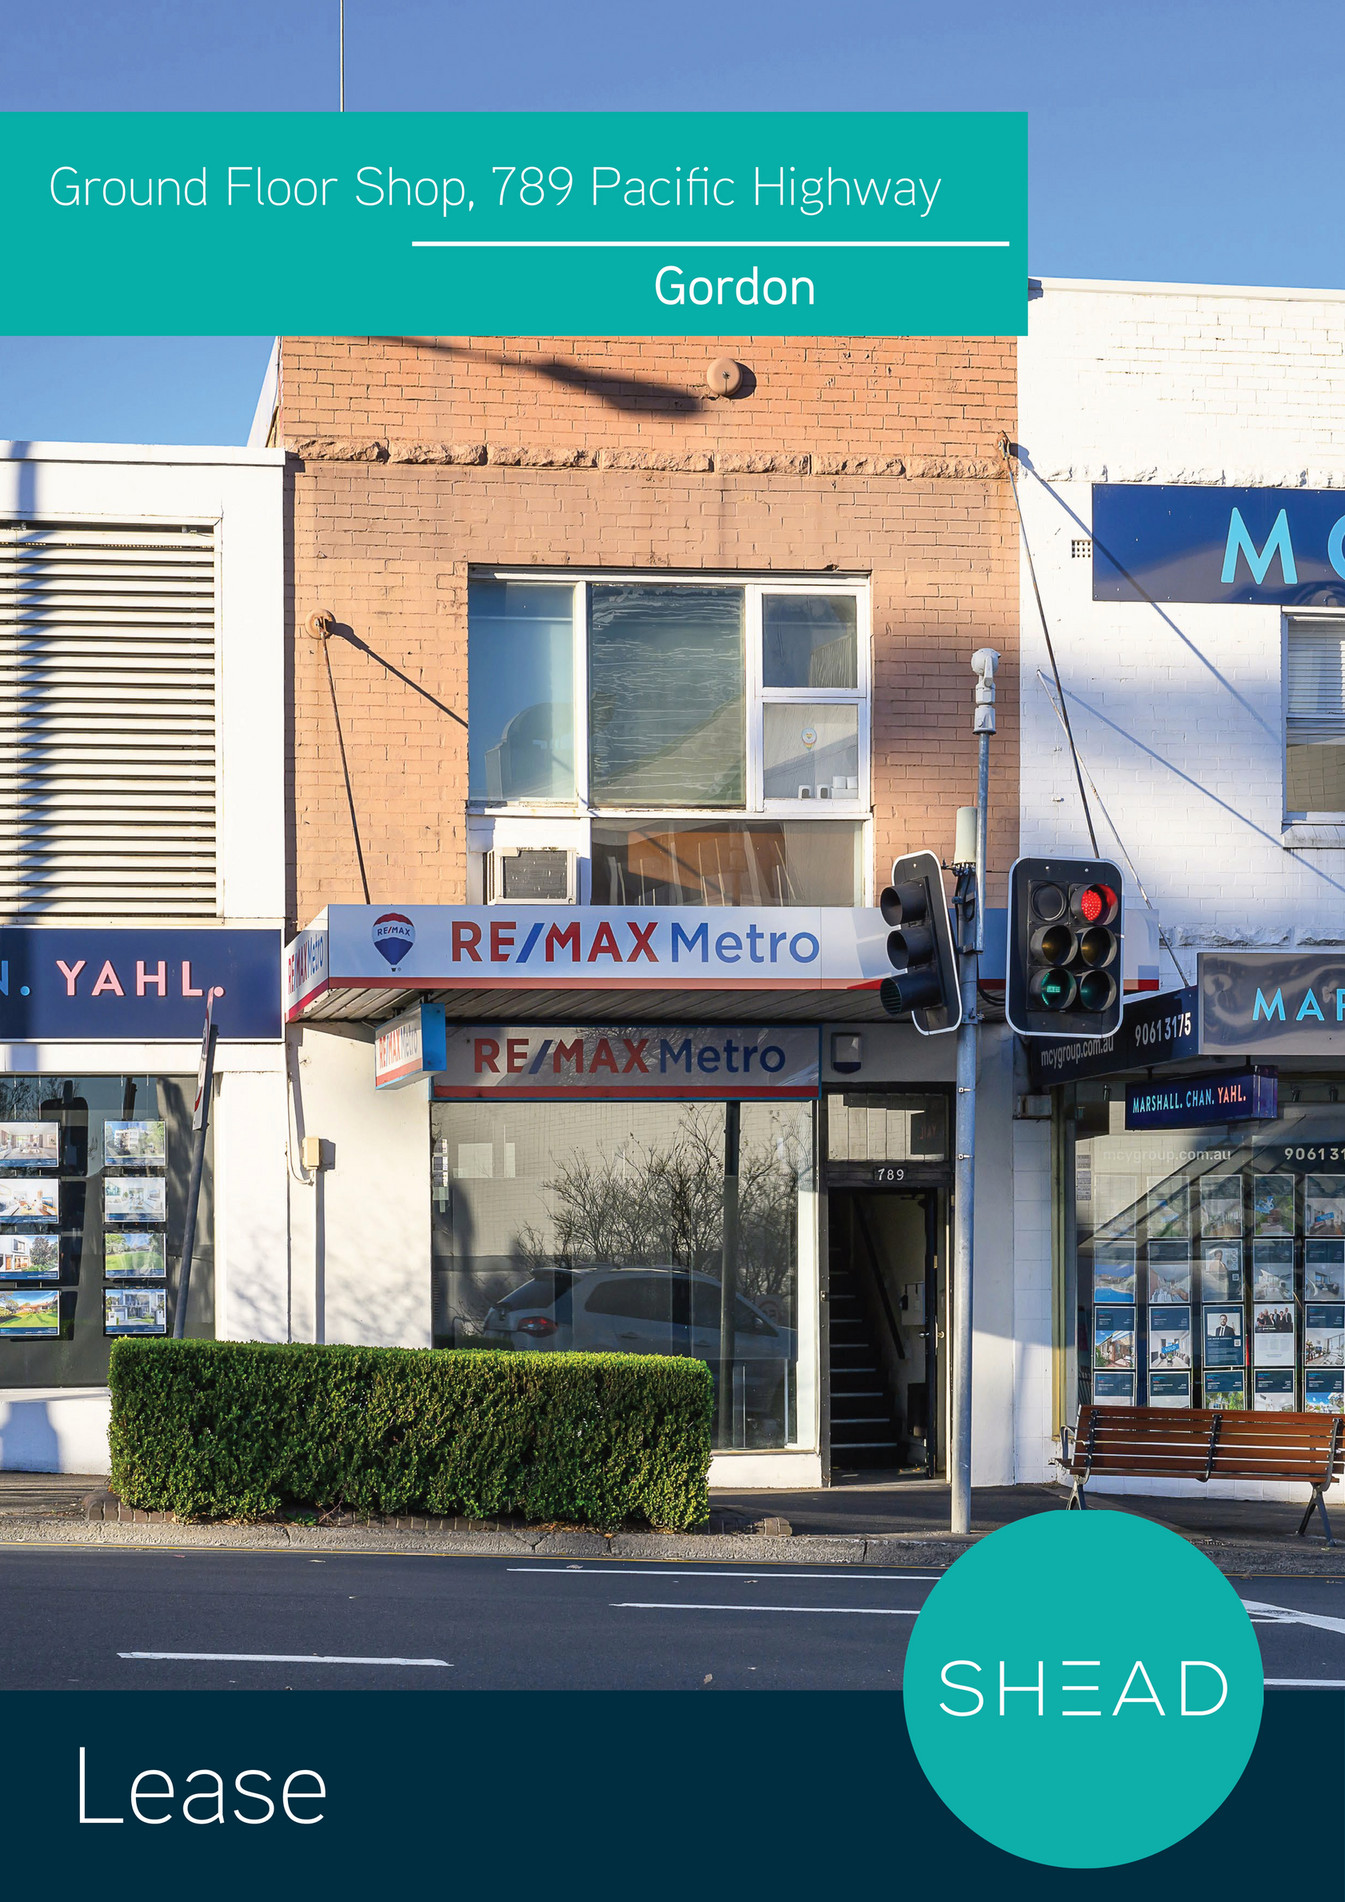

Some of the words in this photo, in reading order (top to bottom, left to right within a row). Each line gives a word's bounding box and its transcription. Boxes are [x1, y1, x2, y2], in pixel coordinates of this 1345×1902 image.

[1220, 506, 1345, 585] M
[377, 926, 411, 936] RE/MAX
[452, 921, 659, 963] RE/MAX
[670, 922, 820, 963] Metro
[307, 932, 324, 979] Metro
[55, 960, 226, 998] YAHL.
[473, 1038, 650, 1075] RE/MAX
[659, 1038, 786, 1074] Metro
[1132, 1093, 1183, 1114] MARSHALL.
[1186, 1088, 1215, 1108] CHAN.
[1217, 1084, 1247, 1104] YAHL.
[1102, 1149, 1231, 1164] mcygroup.com.au
[1285, 1147, 1325, 1160] 9061
[877, 1168, 904, 1181] 789
